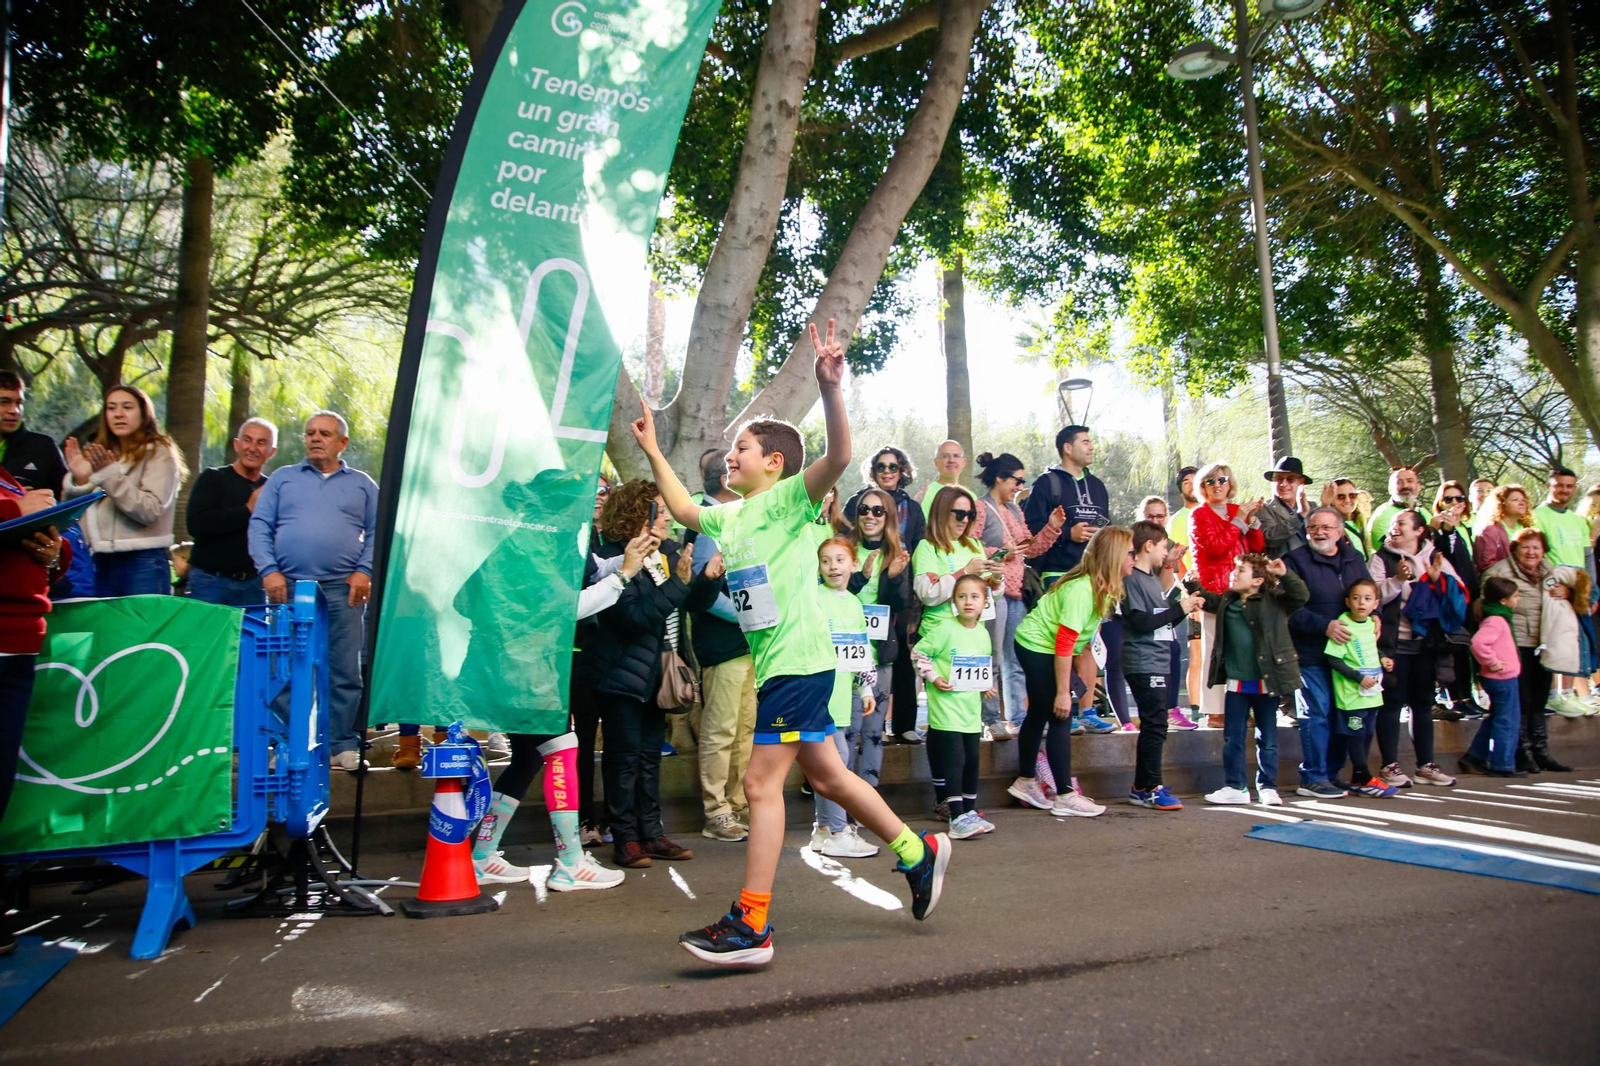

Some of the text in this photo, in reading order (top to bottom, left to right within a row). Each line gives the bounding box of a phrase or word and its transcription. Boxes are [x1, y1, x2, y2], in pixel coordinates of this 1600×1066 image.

[530, 67, 651, 113] Tenemos
[517, 101, 620, 137] un gran
[496, 159, 547, 184] por
[490, 188, 588, 225] delant
[955, 667, 989, 680] 1116
[551, 755, 567, 790] NEW
